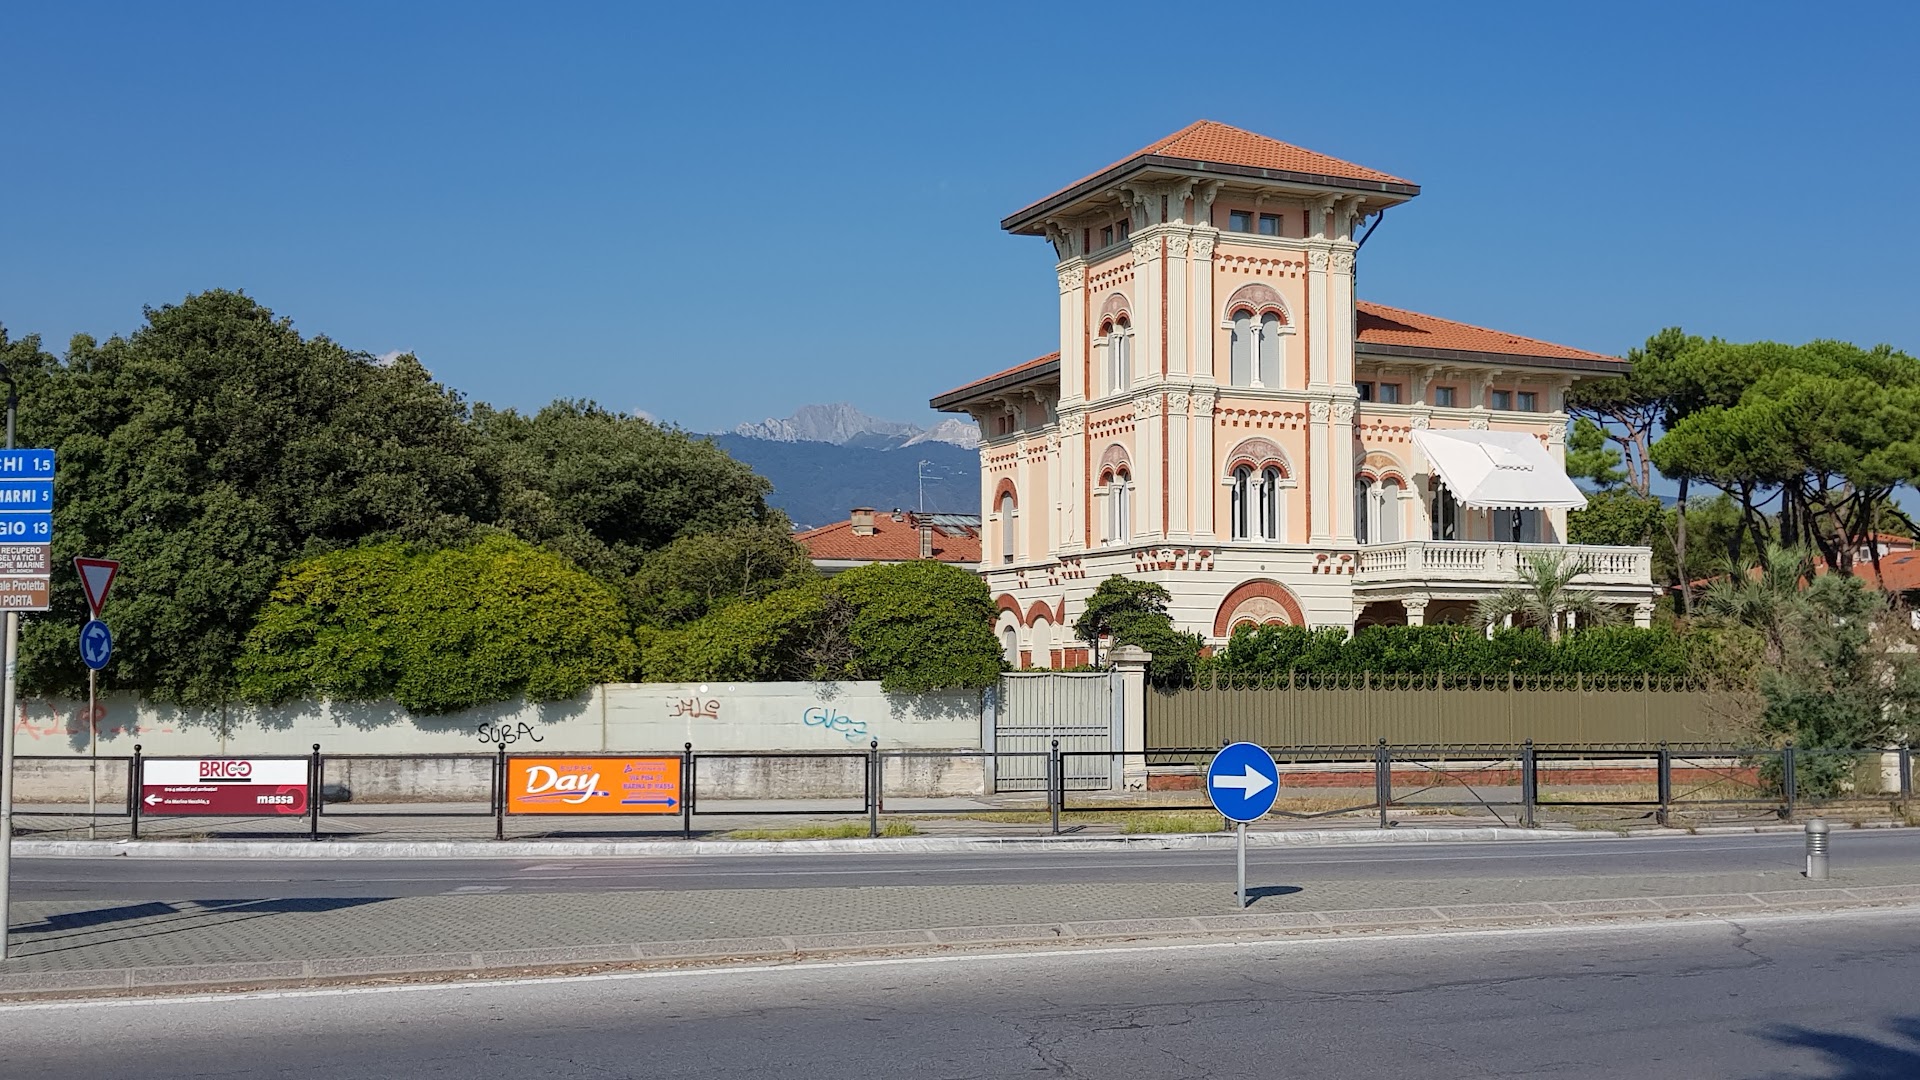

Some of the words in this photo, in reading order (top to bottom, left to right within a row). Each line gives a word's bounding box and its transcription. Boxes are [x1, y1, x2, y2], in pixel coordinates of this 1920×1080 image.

[33, 458, 51, 471] 1.5
[42, 491, 49, 502] 5
[33, 522, 48, 534] 13
[12, 580, 45, 590] Protetta
[3, 595, 33, 606] PORTA
[478, 722, 544, 743] SUBA
[199, 761, 252, 777] BRICO
[525, 765, 601, 805] Day
[256, 795, 294, 804] massa
